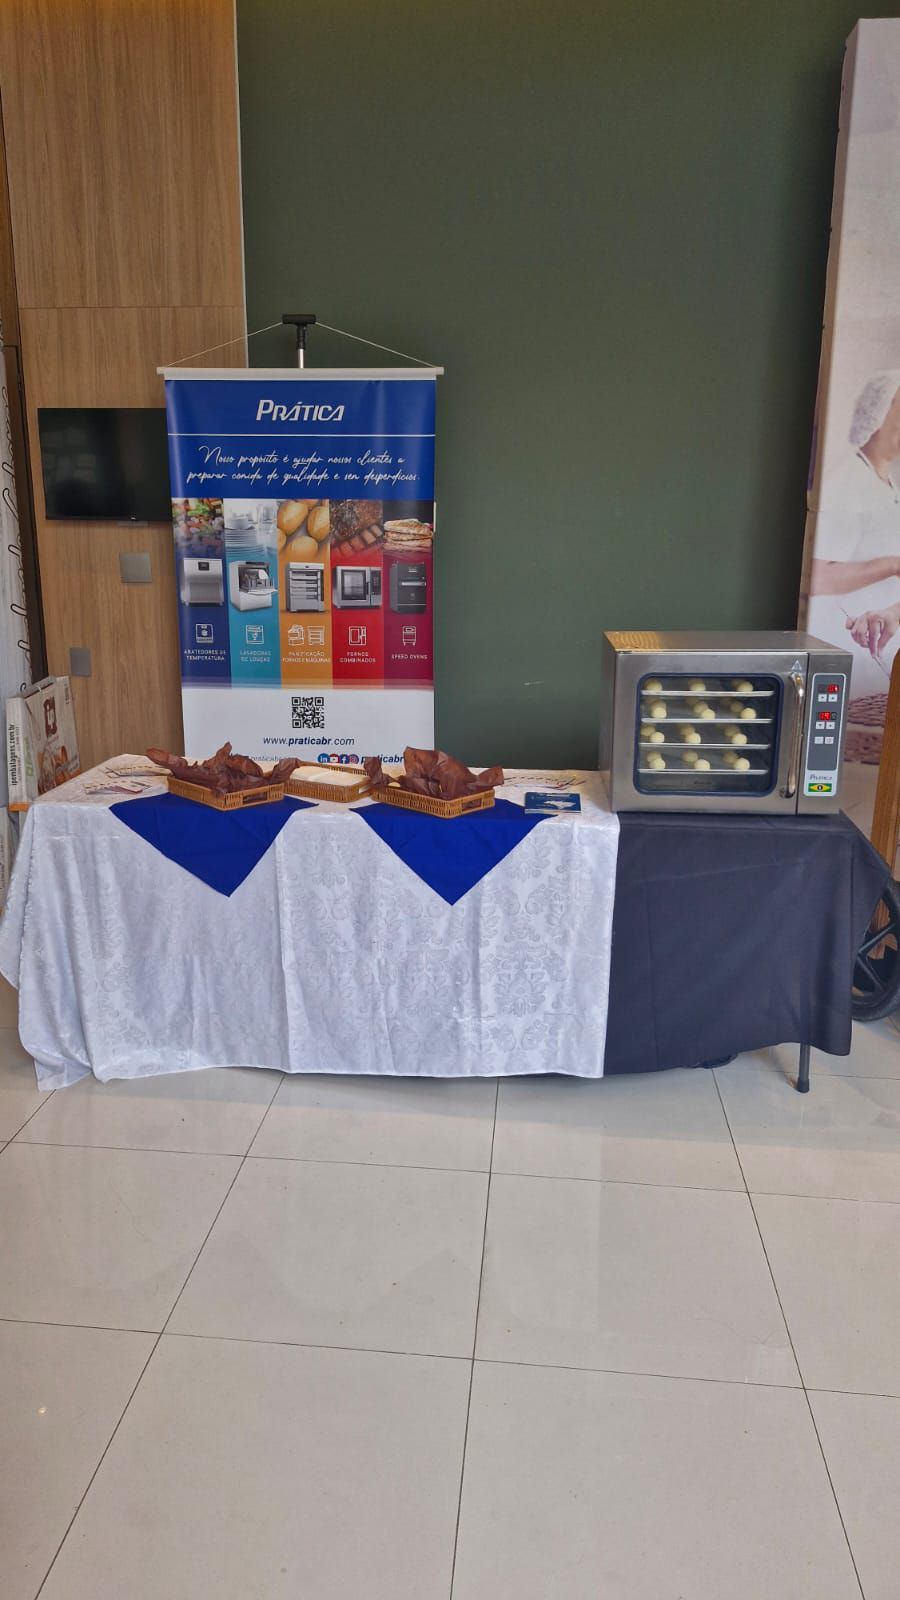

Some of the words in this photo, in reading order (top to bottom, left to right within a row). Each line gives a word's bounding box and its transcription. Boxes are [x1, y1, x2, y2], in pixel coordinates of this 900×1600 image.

[256, 399, 345, 421] PRÁTICA
[199, 446, 235, 465] Nosso
[283, 455, 290, 463] é
[292, 451, 323, 469] ajudar
[356, 449, 392, 465] clientes
[186, 470, 227, 484] preparar
[231, 468, 263, 485] comida
[266, 468, 279, 485] de
[281, 466, 329, 486] qualidade
[263, 736, 355, 747] www.praticabr.com
